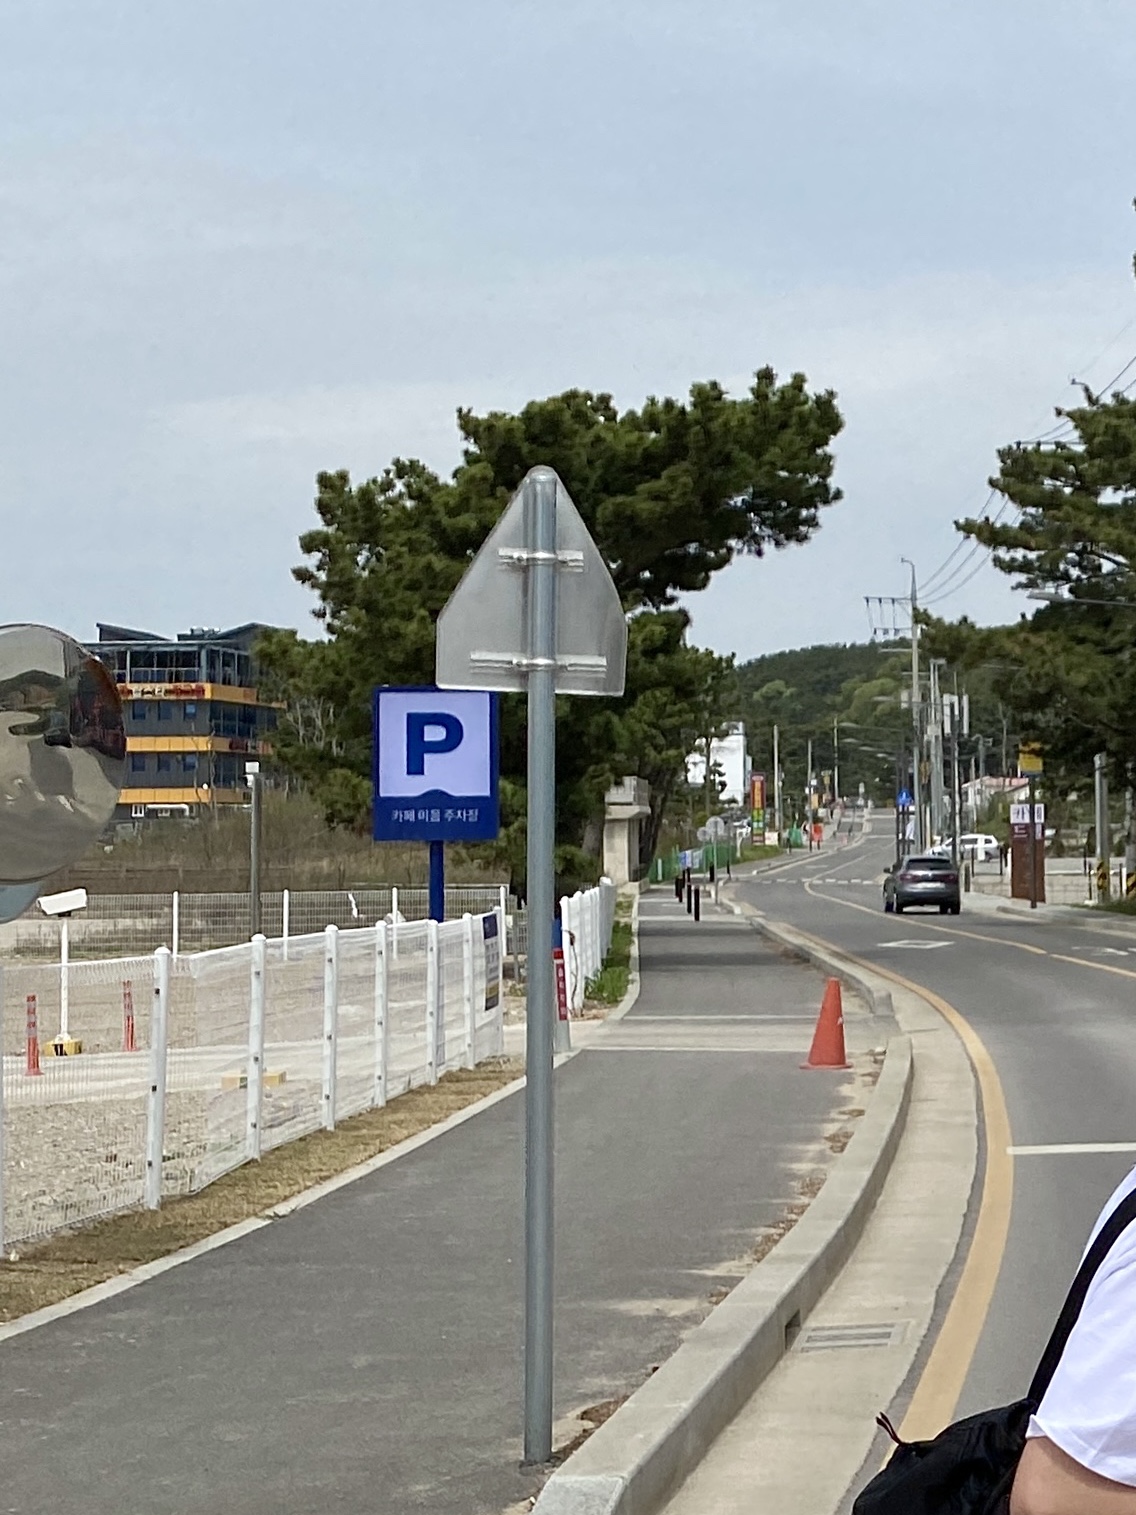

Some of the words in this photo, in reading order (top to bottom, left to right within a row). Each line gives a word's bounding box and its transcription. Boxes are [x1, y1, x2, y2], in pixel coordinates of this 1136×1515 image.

[406, 712, 464, 775] P
[391, 808, 416, 823] 카페
[444, 808, 479, 823] 주차장
